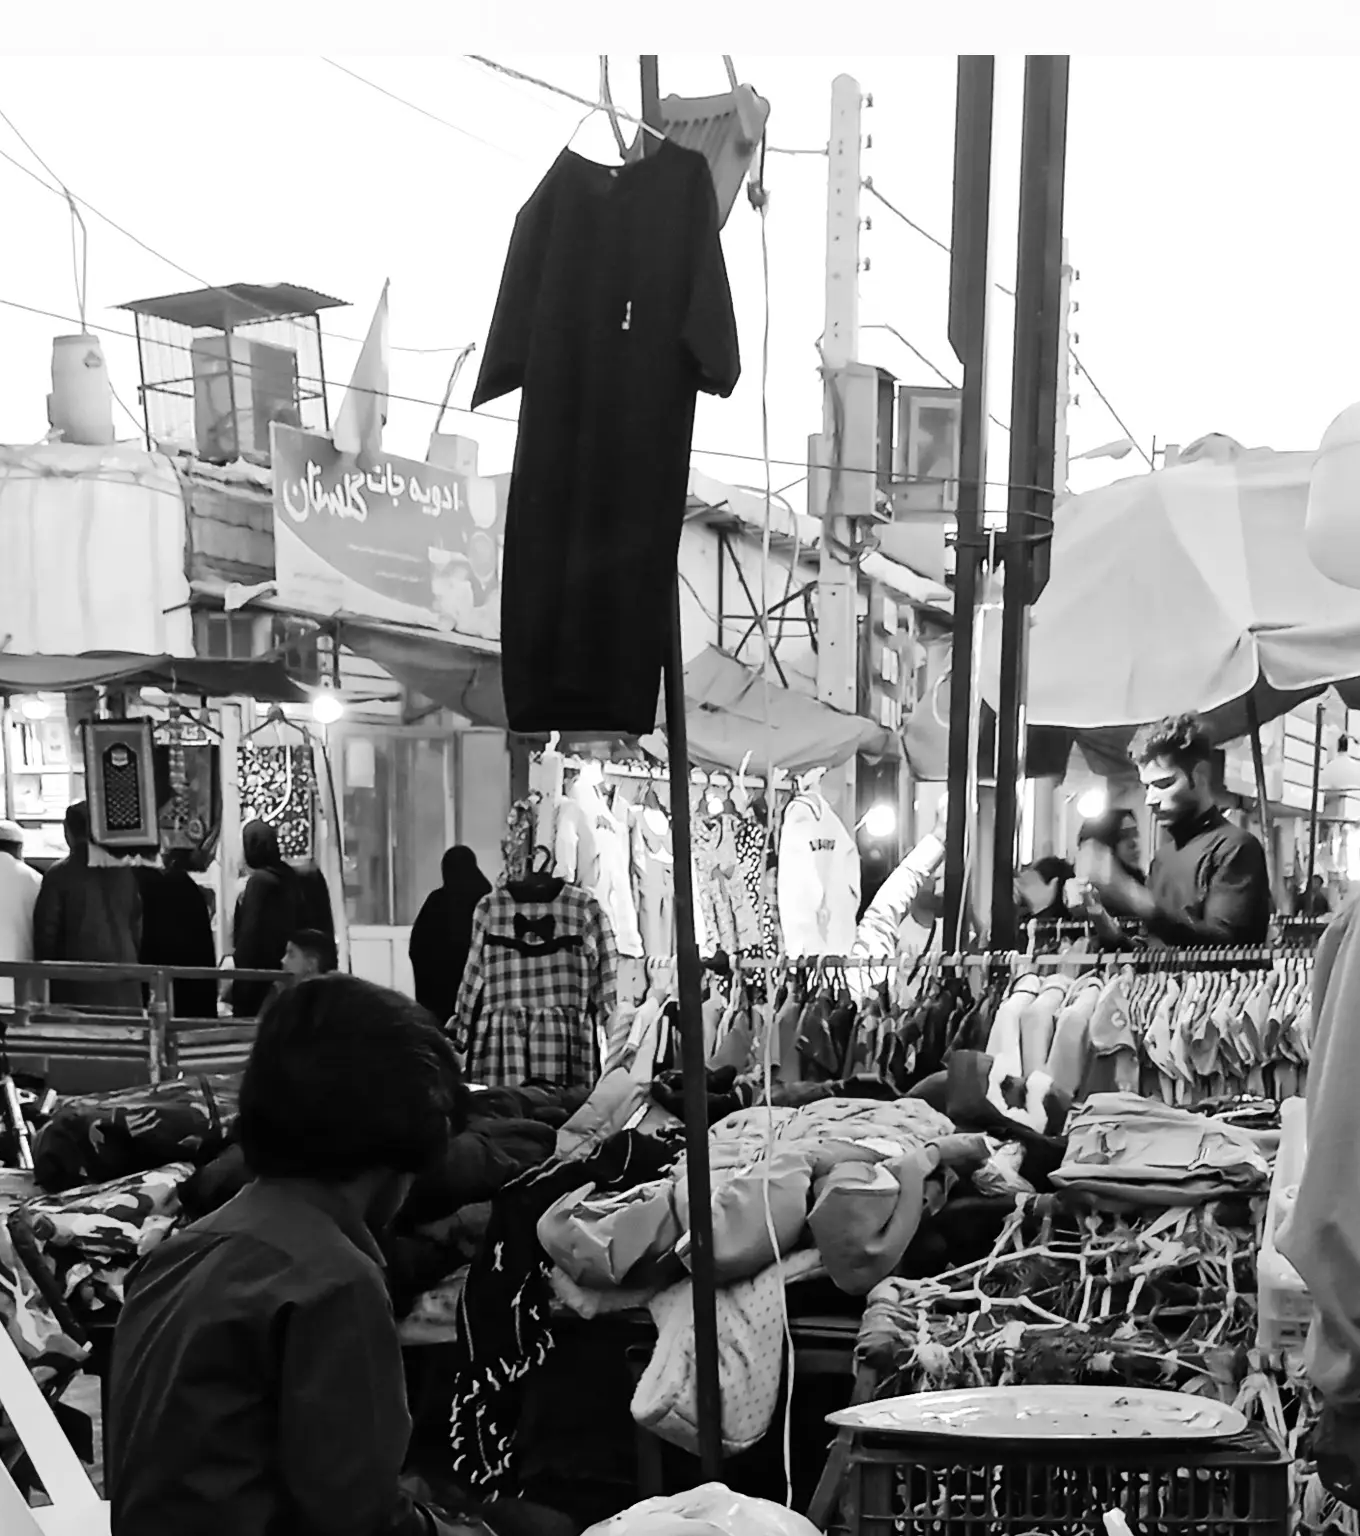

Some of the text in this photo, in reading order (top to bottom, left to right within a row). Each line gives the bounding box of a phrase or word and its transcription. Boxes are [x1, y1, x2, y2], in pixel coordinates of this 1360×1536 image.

[282, 459, 460, 523] ادویه جات گلستان
